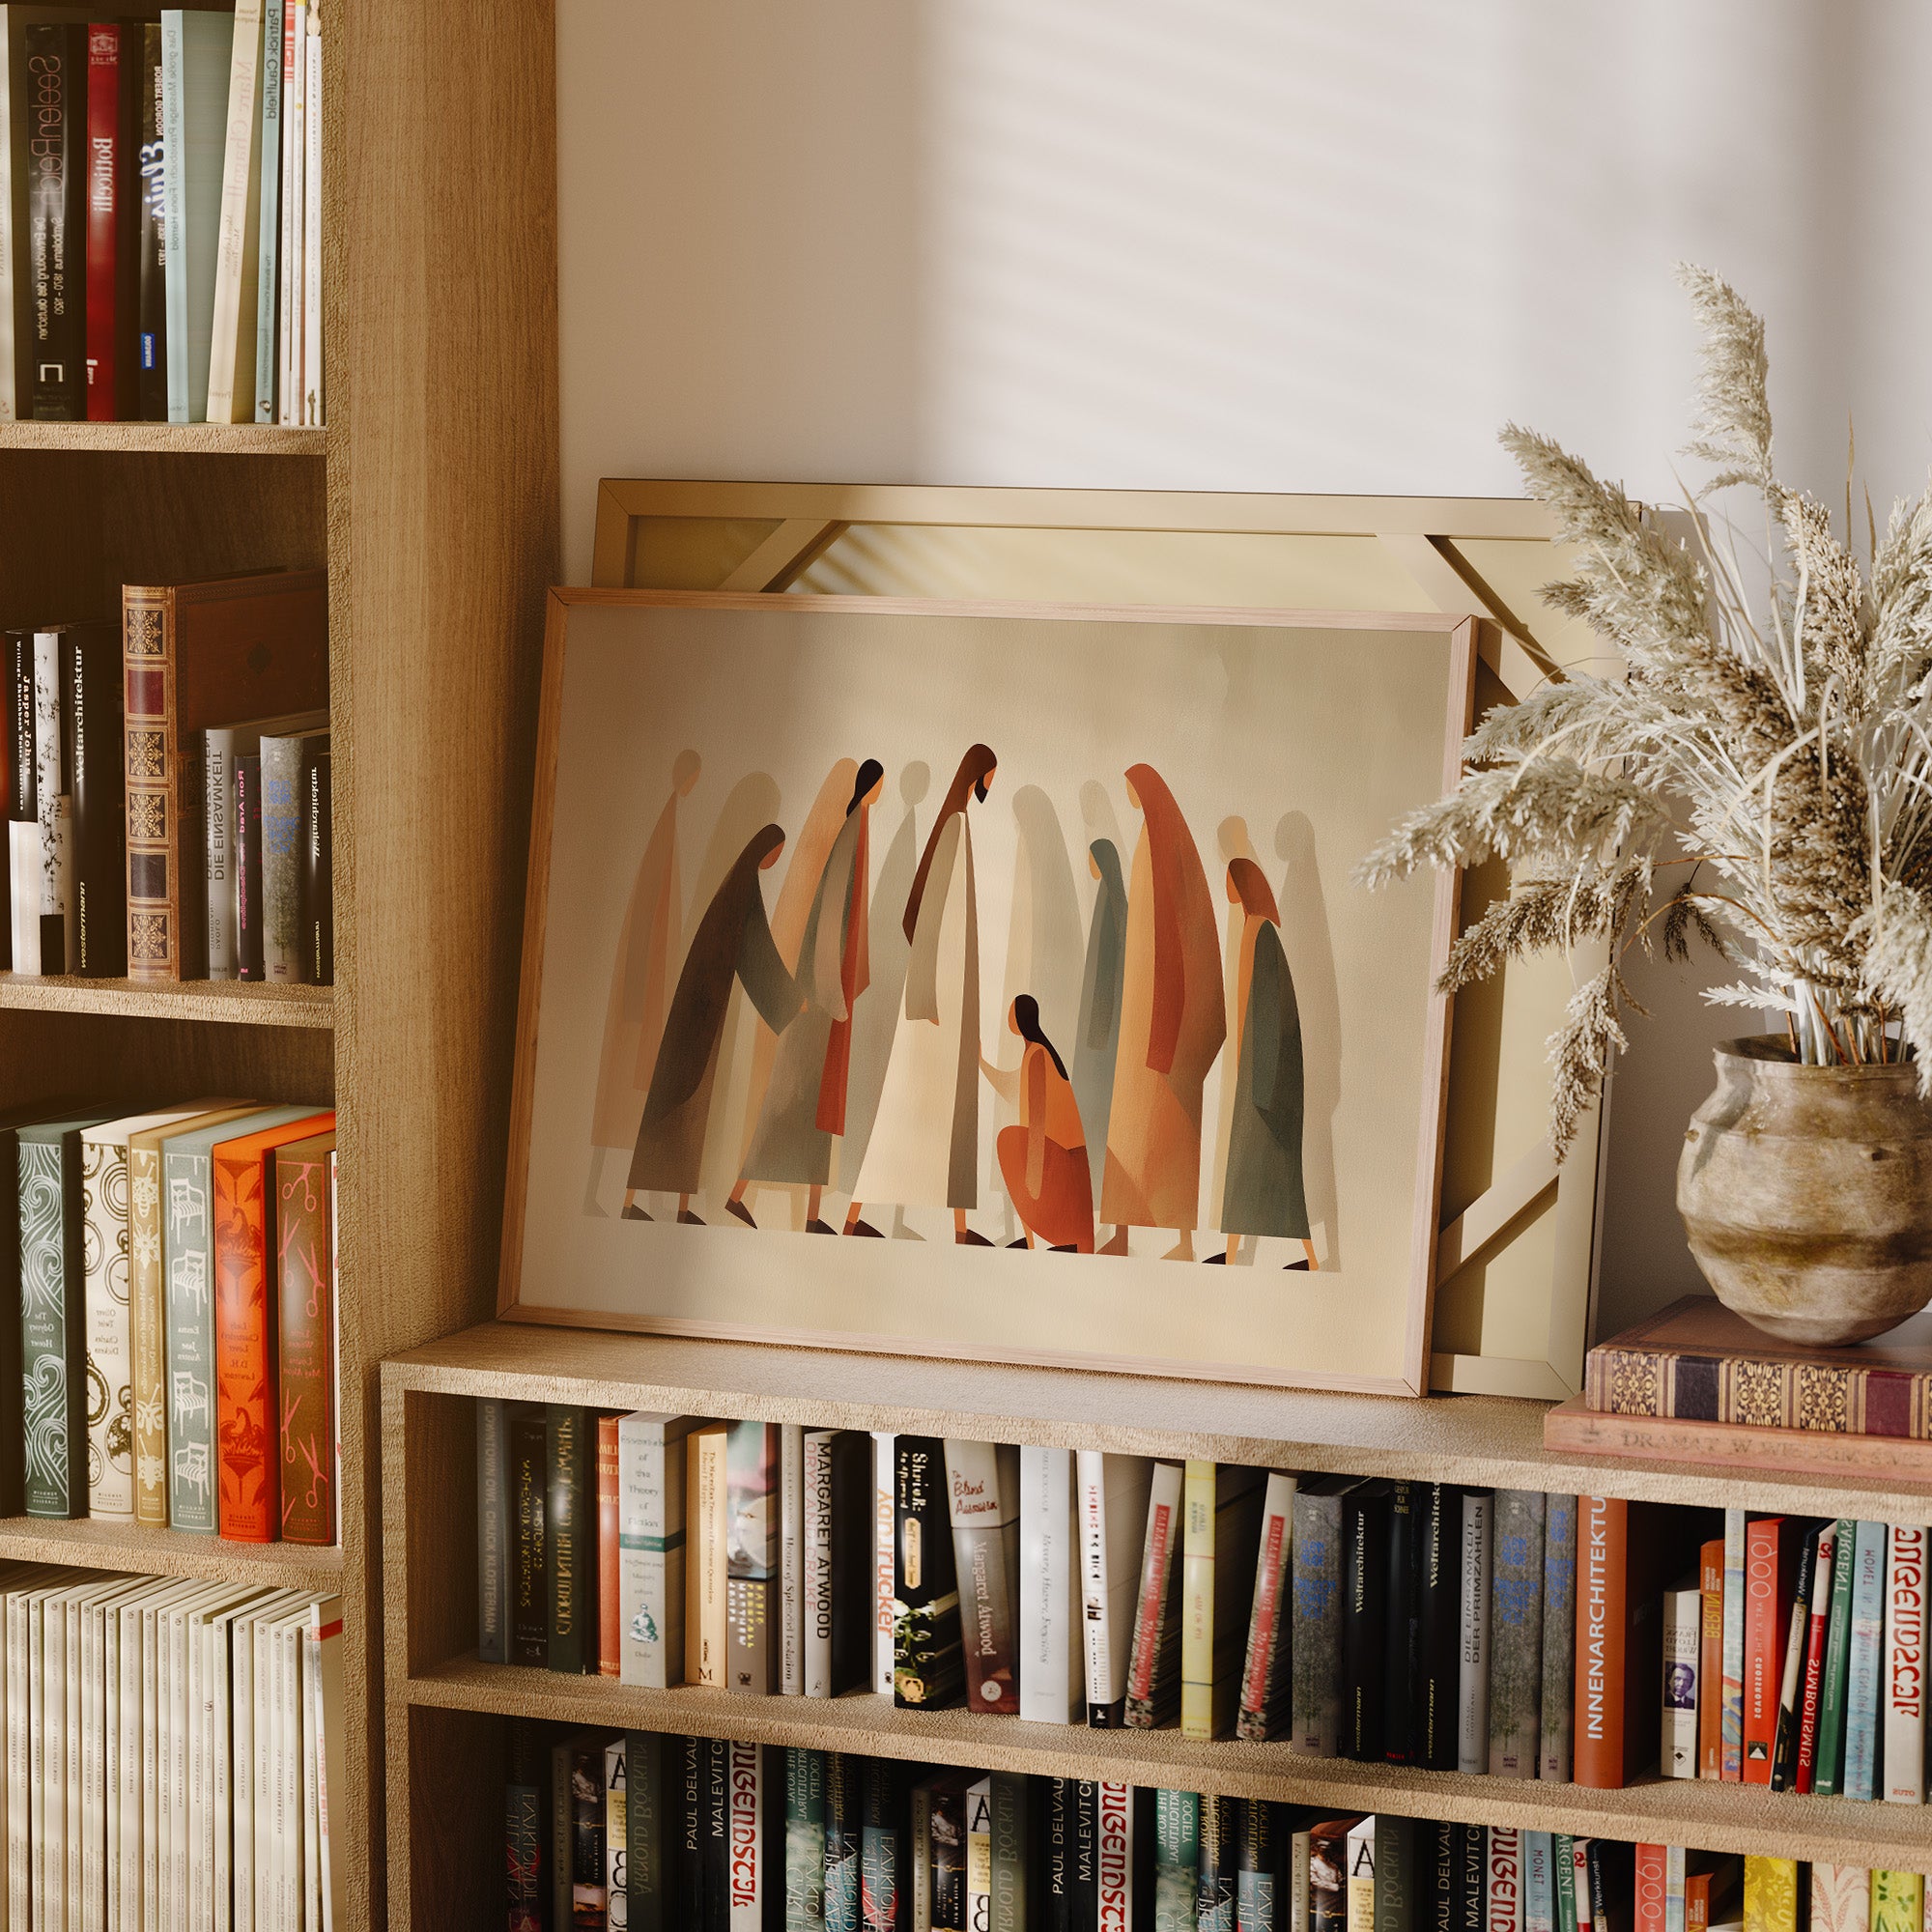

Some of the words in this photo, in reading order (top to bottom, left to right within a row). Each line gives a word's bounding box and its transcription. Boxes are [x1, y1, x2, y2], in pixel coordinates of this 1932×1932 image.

[74, 645, 85, 784] Weltarchitektur
[24, 730, 33, 775] Johns
[484, 1405, 497, 1477] DOWNTOWN
[638, 1452, 648, 1462] of
[1732, 1438, 1751, 1455] W
[484, 1478, 497, 1504] OWL
[629, 1484, 659, 1498] Theory
[635, 1468, 651, 1479] the
[805, 1440, 817, 1496] ORYX
[953, 1480, 984, 1497] Blind
[638, 1501, 649, 1511] of
[817, 1441, 832, 1552] MARGARET
[484, 1511, 497, 1552] CHUCK
[805, 1498, 817, 1545] AND
[805, 1546, 817, 1612] CRAKE
[972, 1541, 990, 1600] Margaret
[1354, 1510, 1365, 1614] Weltarchitektur
[1464, 1520, 1474, 1629] EINSAMKEIT
[1472, 1506, 1483, 1623] PRIMZAHLEN
[484, 1554, 497, 1634] KLOSTERMAN
[816, 1555, 832, 1640] ATWOOD
[978, 1603, 998, 1656] Atwood
[1472, 1627, 1481, 1664] DER
[1427, 1679, 1435, 1759] westermann
[686, 1807, 697, 1850] PAUL
[1052, 1777, 1065, 1846] DELVAU
[1052, 1852, 1064, 1895] PAUL
[1353, 1838, 1376, 1878] A
[1532, 1849, 1545, 1886] MONET
[1573, 1851, 1586, 1869] 2
[1593, 1861, 1603, 1908] Werkkunst
[1641, 1856, 1662, 1919] 1900
